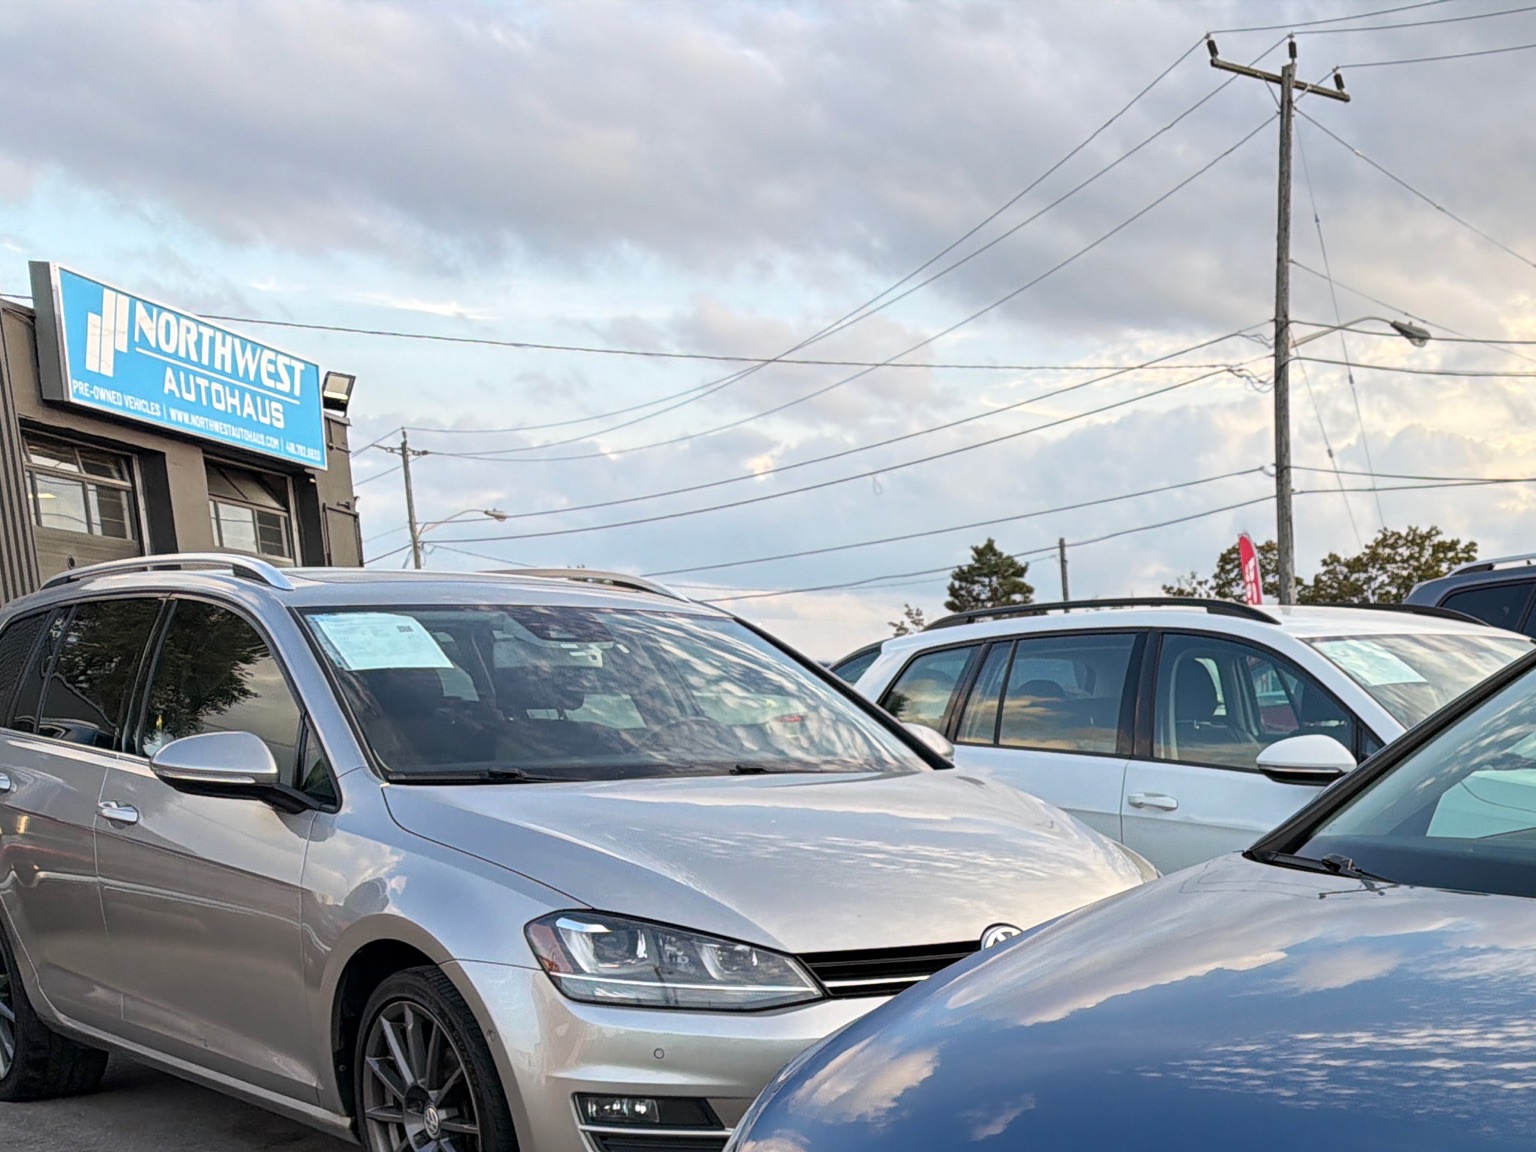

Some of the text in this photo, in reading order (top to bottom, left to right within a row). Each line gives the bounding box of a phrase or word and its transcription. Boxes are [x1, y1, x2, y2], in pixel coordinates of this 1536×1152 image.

[135, 300, 305, 396] NORTHWEST
[72, 379, 122, 406] PRE-OWNED
[124, 394, 161, 417] VEHICLES
[169, 408, 279, 450] WWW.NORTHWESTAUTOHAUS.COM
[164, 367, 285, 429] AUTOHAUS
